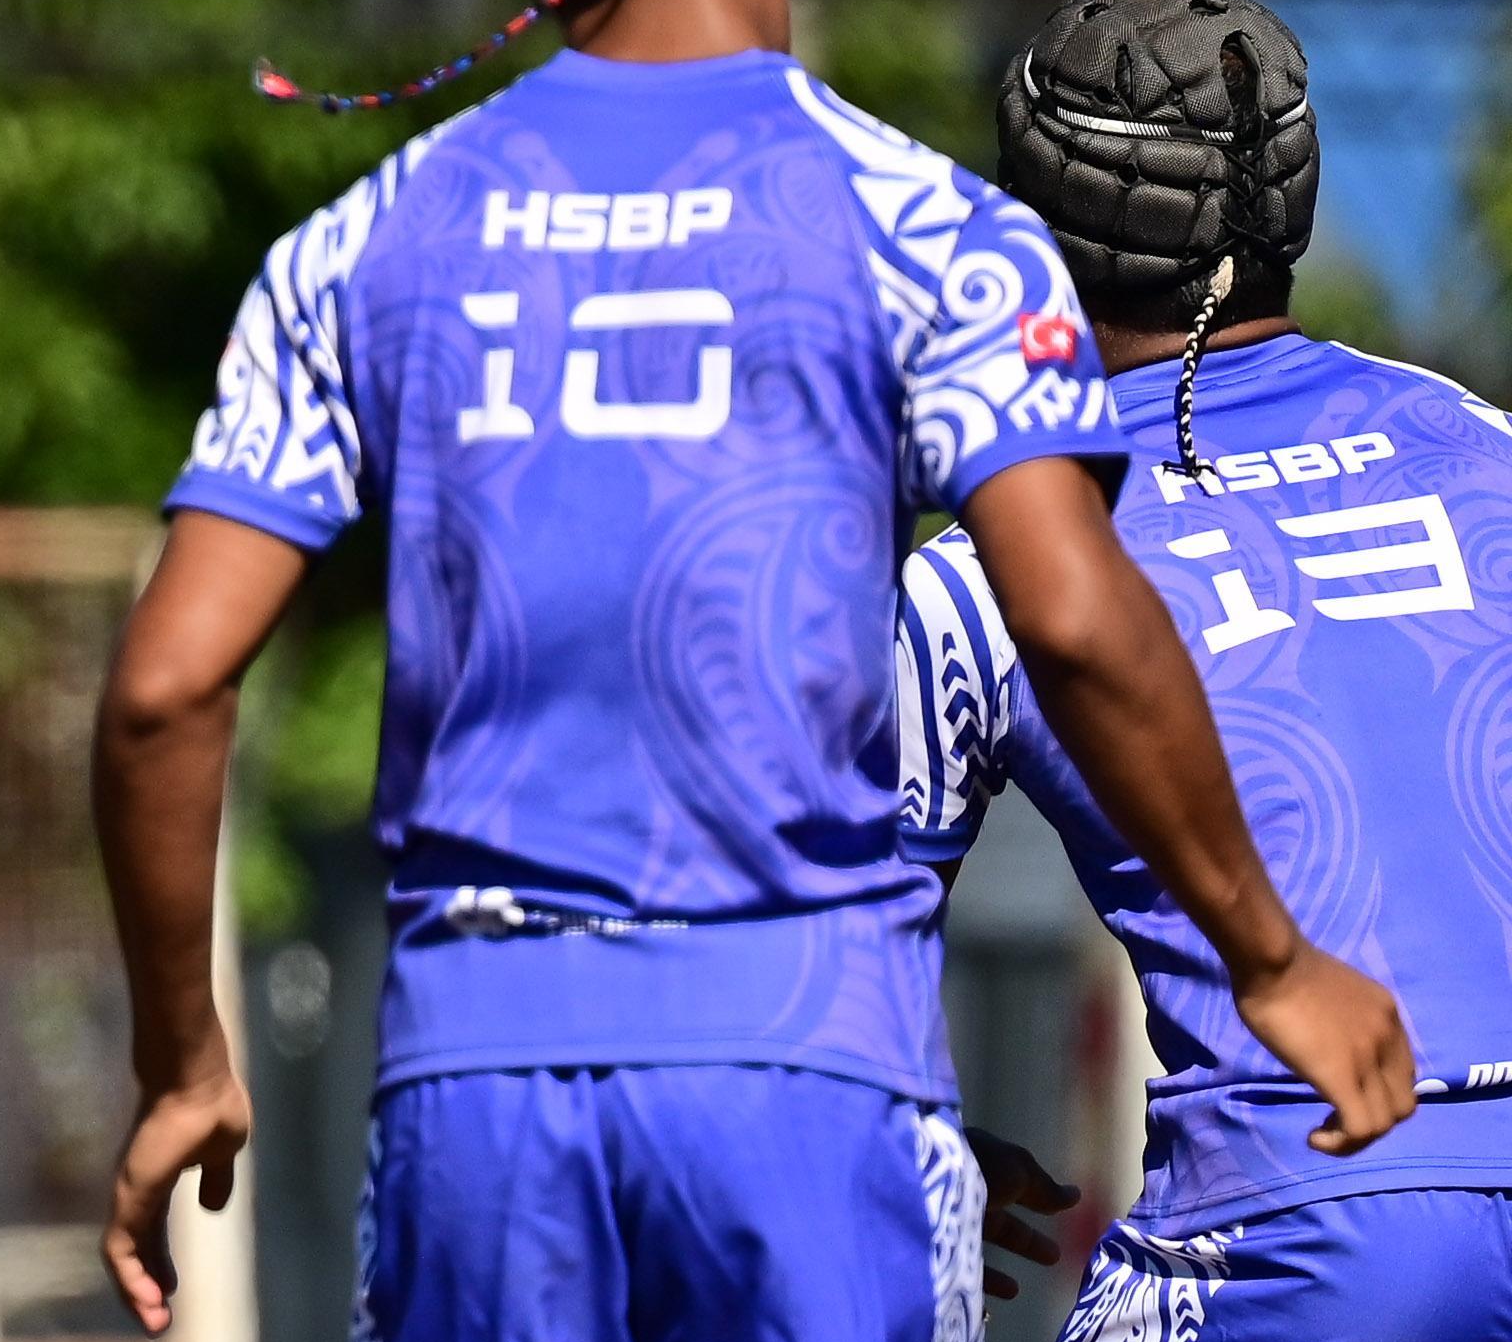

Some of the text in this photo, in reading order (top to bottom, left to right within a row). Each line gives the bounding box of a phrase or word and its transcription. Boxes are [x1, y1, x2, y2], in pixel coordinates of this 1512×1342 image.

[479, 188, 734, 253] HSBP
[458, 288, 734, 443] 10
[1151, 431, 1396, 506] HSBP
[1165, 493, 1476, 656] 13
